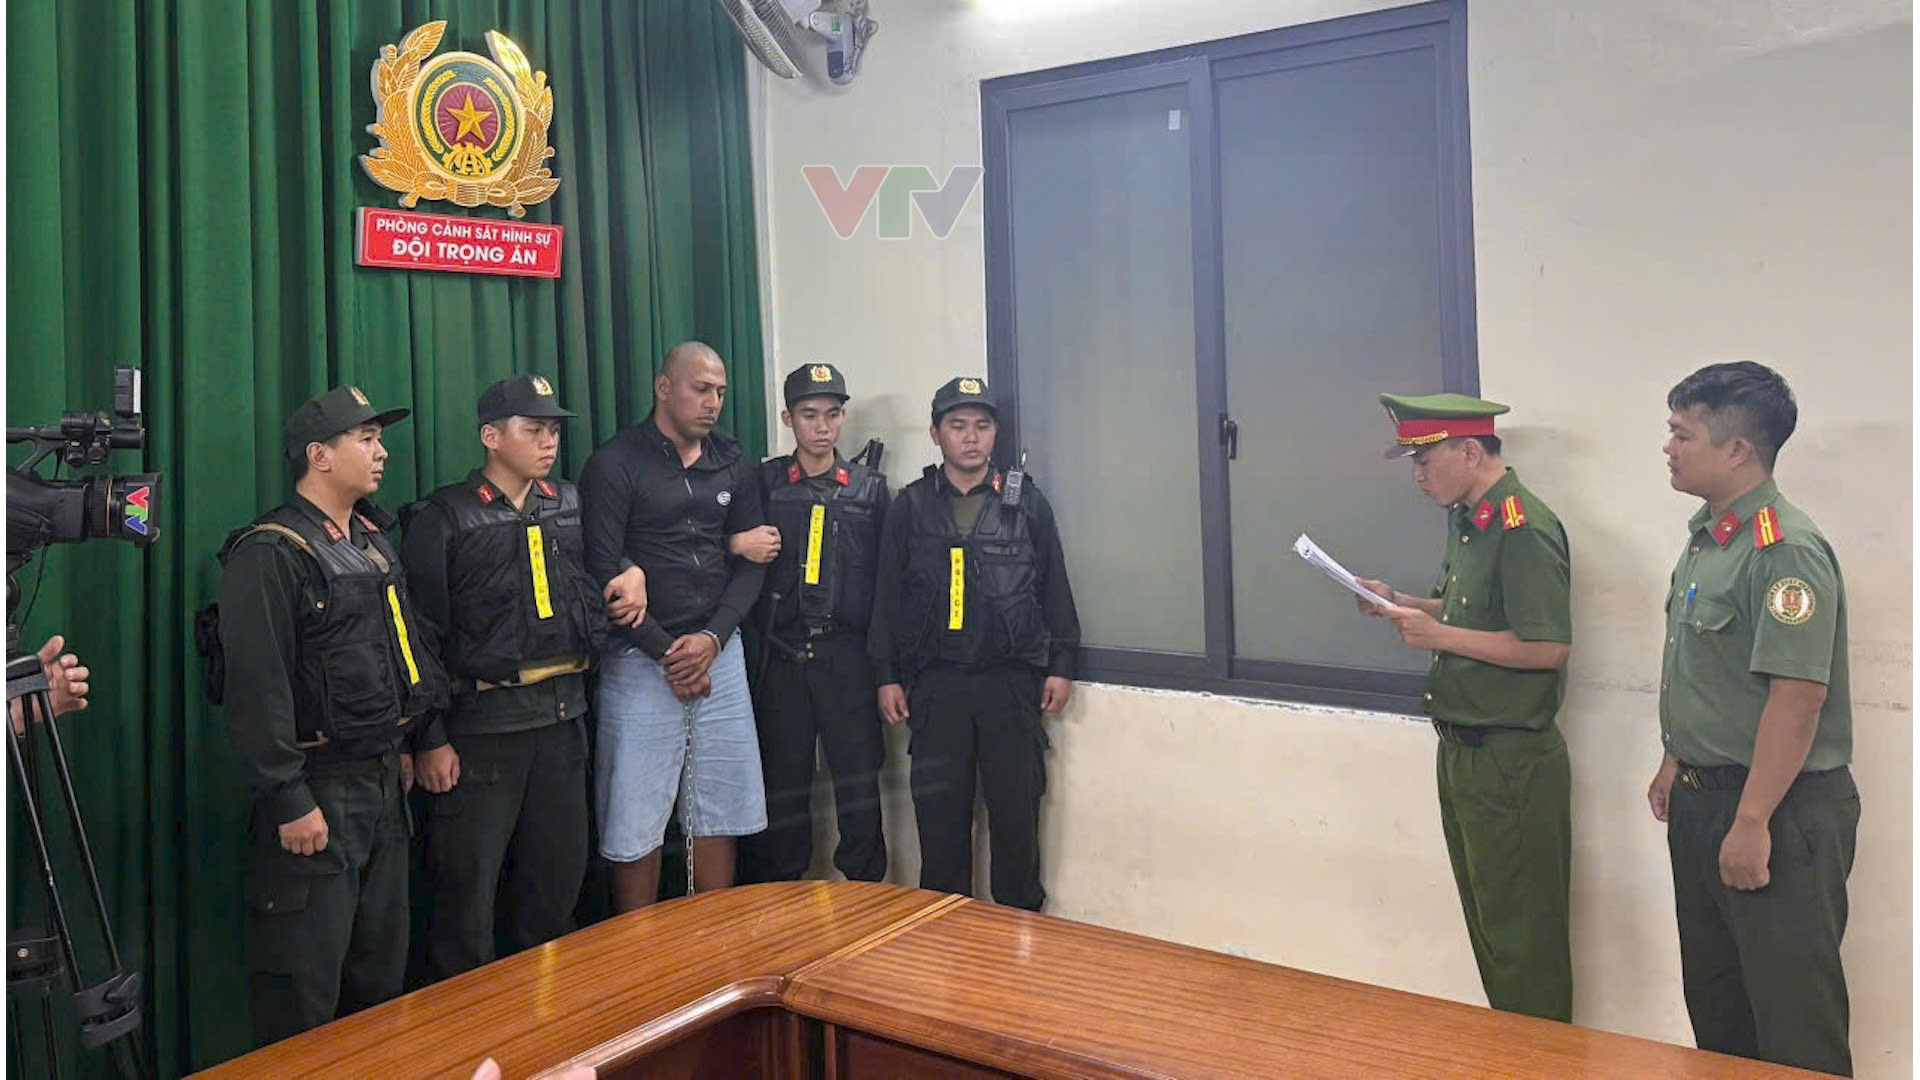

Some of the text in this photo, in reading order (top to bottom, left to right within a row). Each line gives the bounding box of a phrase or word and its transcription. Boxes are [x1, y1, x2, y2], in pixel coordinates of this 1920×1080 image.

[376, 216, 552, 248] PHÒNG CẢNH SÁT HÌNH SỰ
[392, 236, 537, 265] ĐỘI TRỌNG ÁN
[124, 486, 150, 536] VTV
